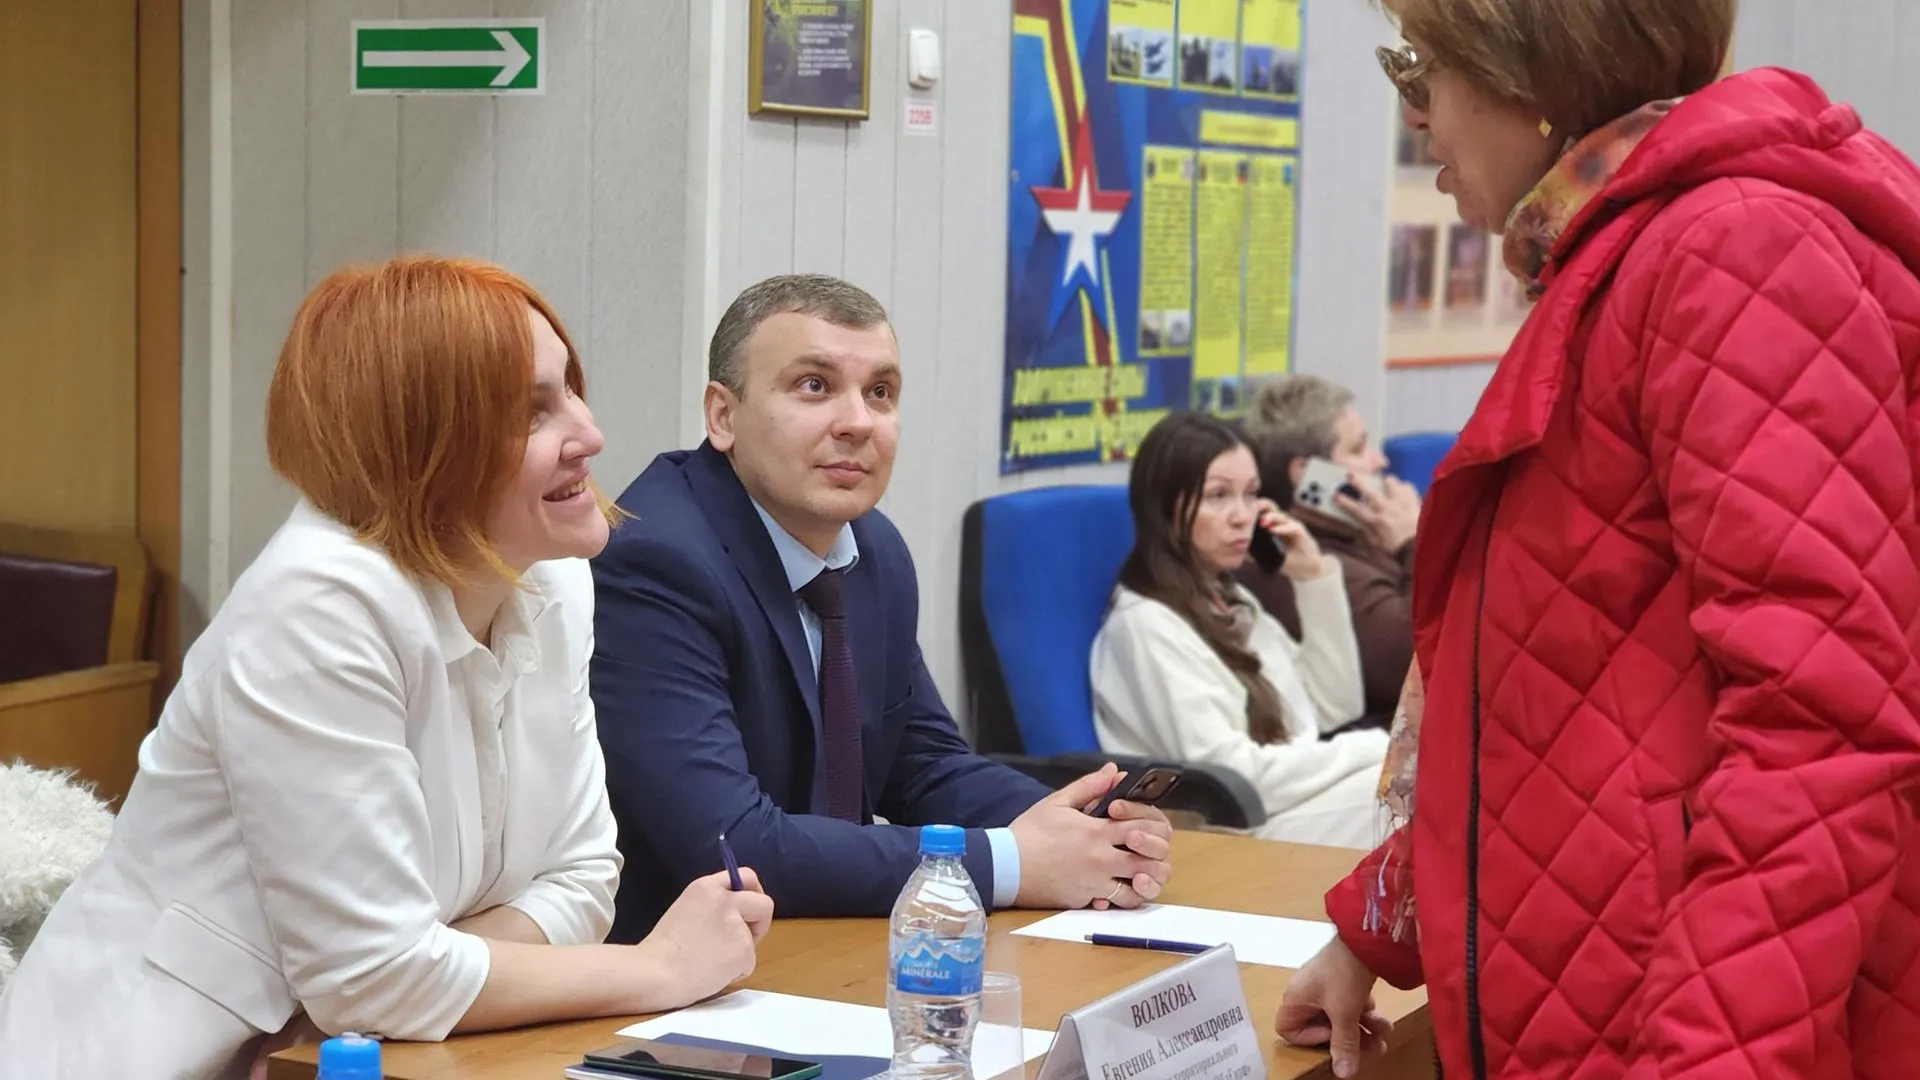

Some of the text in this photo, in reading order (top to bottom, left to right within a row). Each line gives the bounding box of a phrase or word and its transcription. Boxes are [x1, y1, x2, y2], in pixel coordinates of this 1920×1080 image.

[1130, 979, 1198, 1028] ВОЛКОВА
[1101, 1005, 1245, 1080] Евгения Александровна
